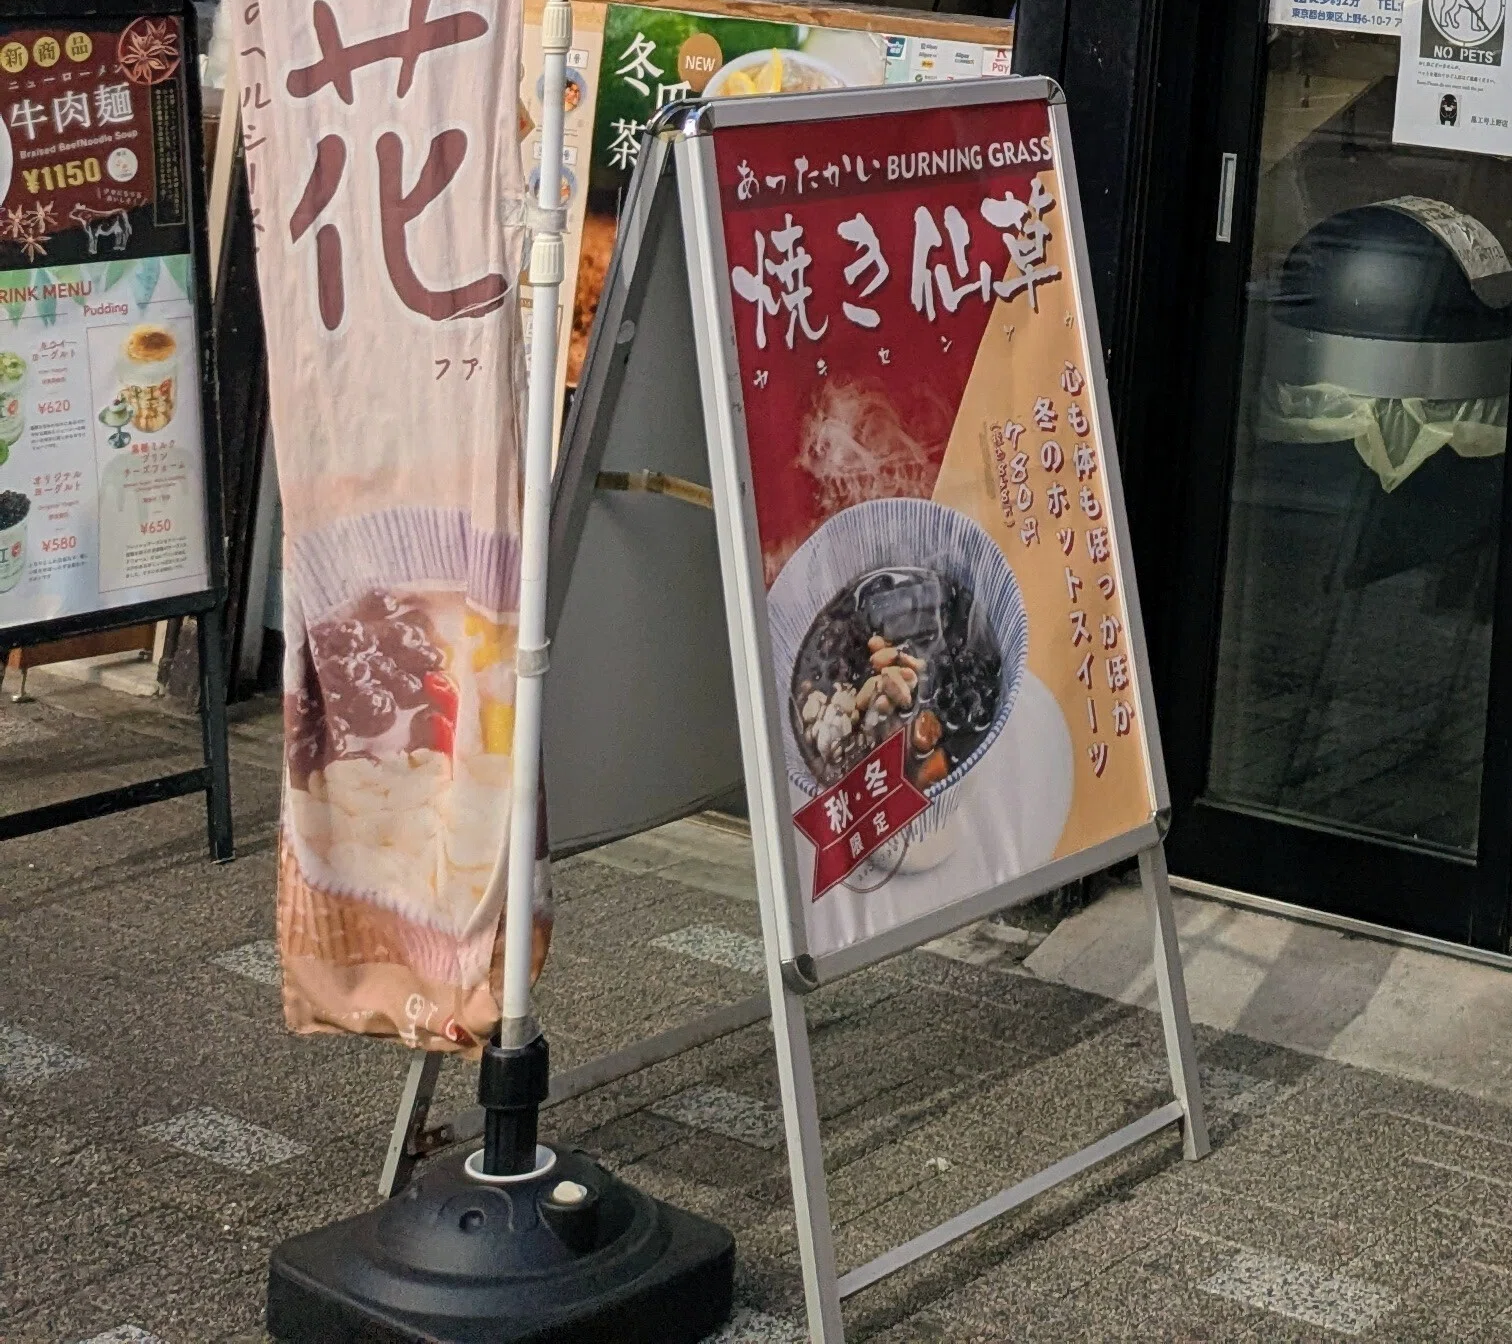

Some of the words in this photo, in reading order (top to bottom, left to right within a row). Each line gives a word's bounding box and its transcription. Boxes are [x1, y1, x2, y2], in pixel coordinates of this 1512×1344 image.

[4, 35, 89, 68] 新商品
[684, 54, 717, 73] NEW
[1433, 45, 1452, 59] NO
[1460, 49, 1494, 64] PETS
[992, 63, 1010, 75] Pay
[20, 145, 56, 160] Braised
[114, 129, 138, 141] Soup
[22, 157, 102, 194] ¥1150
[737, 154, 881, 200] あったかい
[887, 145, 982, 180] BURNING
[988, 136, 1053, 168] GRASS
[732, 178, 1062, 350] 焼き仙草
[43, 280, 92, 300] MENU
[83, 303, 129, 317] Pudding
[38, 399, 71, 415] ¥620
[140, 518, 171, 534] ¥650
[42, 535, 77, 552] ¥580
[1061, 360, 1136, 737] 心も体もほっかほか
[1033, 396, 1109, 779] 冬のホットスイーツ
[823, 758, 889, 834] 秋・冬
[849, 810, 890, 859] 限定
